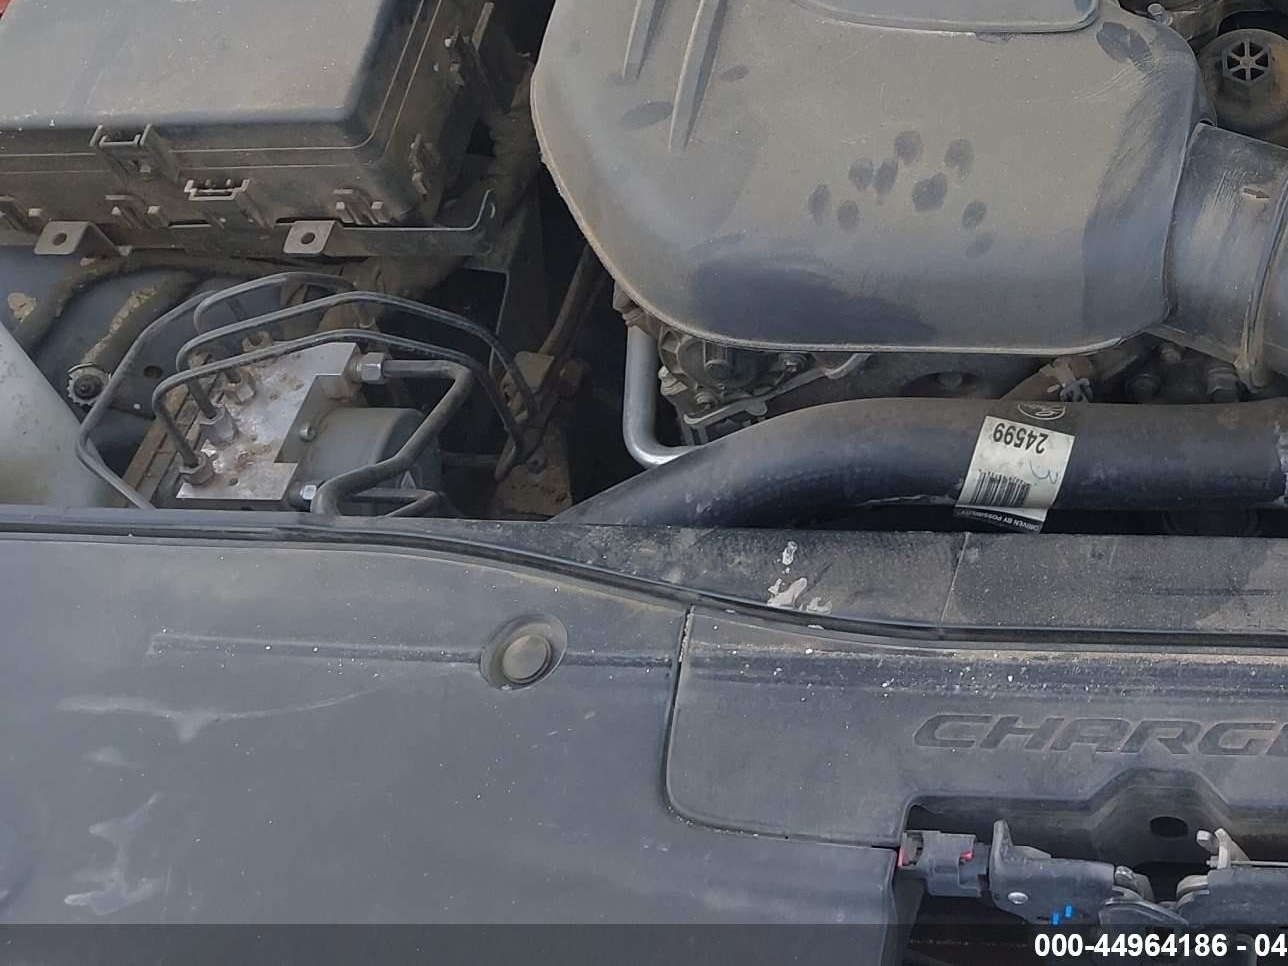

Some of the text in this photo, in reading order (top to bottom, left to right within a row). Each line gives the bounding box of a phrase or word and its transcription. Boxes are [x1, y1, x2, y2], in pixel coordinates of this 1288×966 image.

[993, 423, 1048, 454] 24599
[1002, 515, 1013, 525] BY
[1012, 517, 1040, 532] DRIVEN
